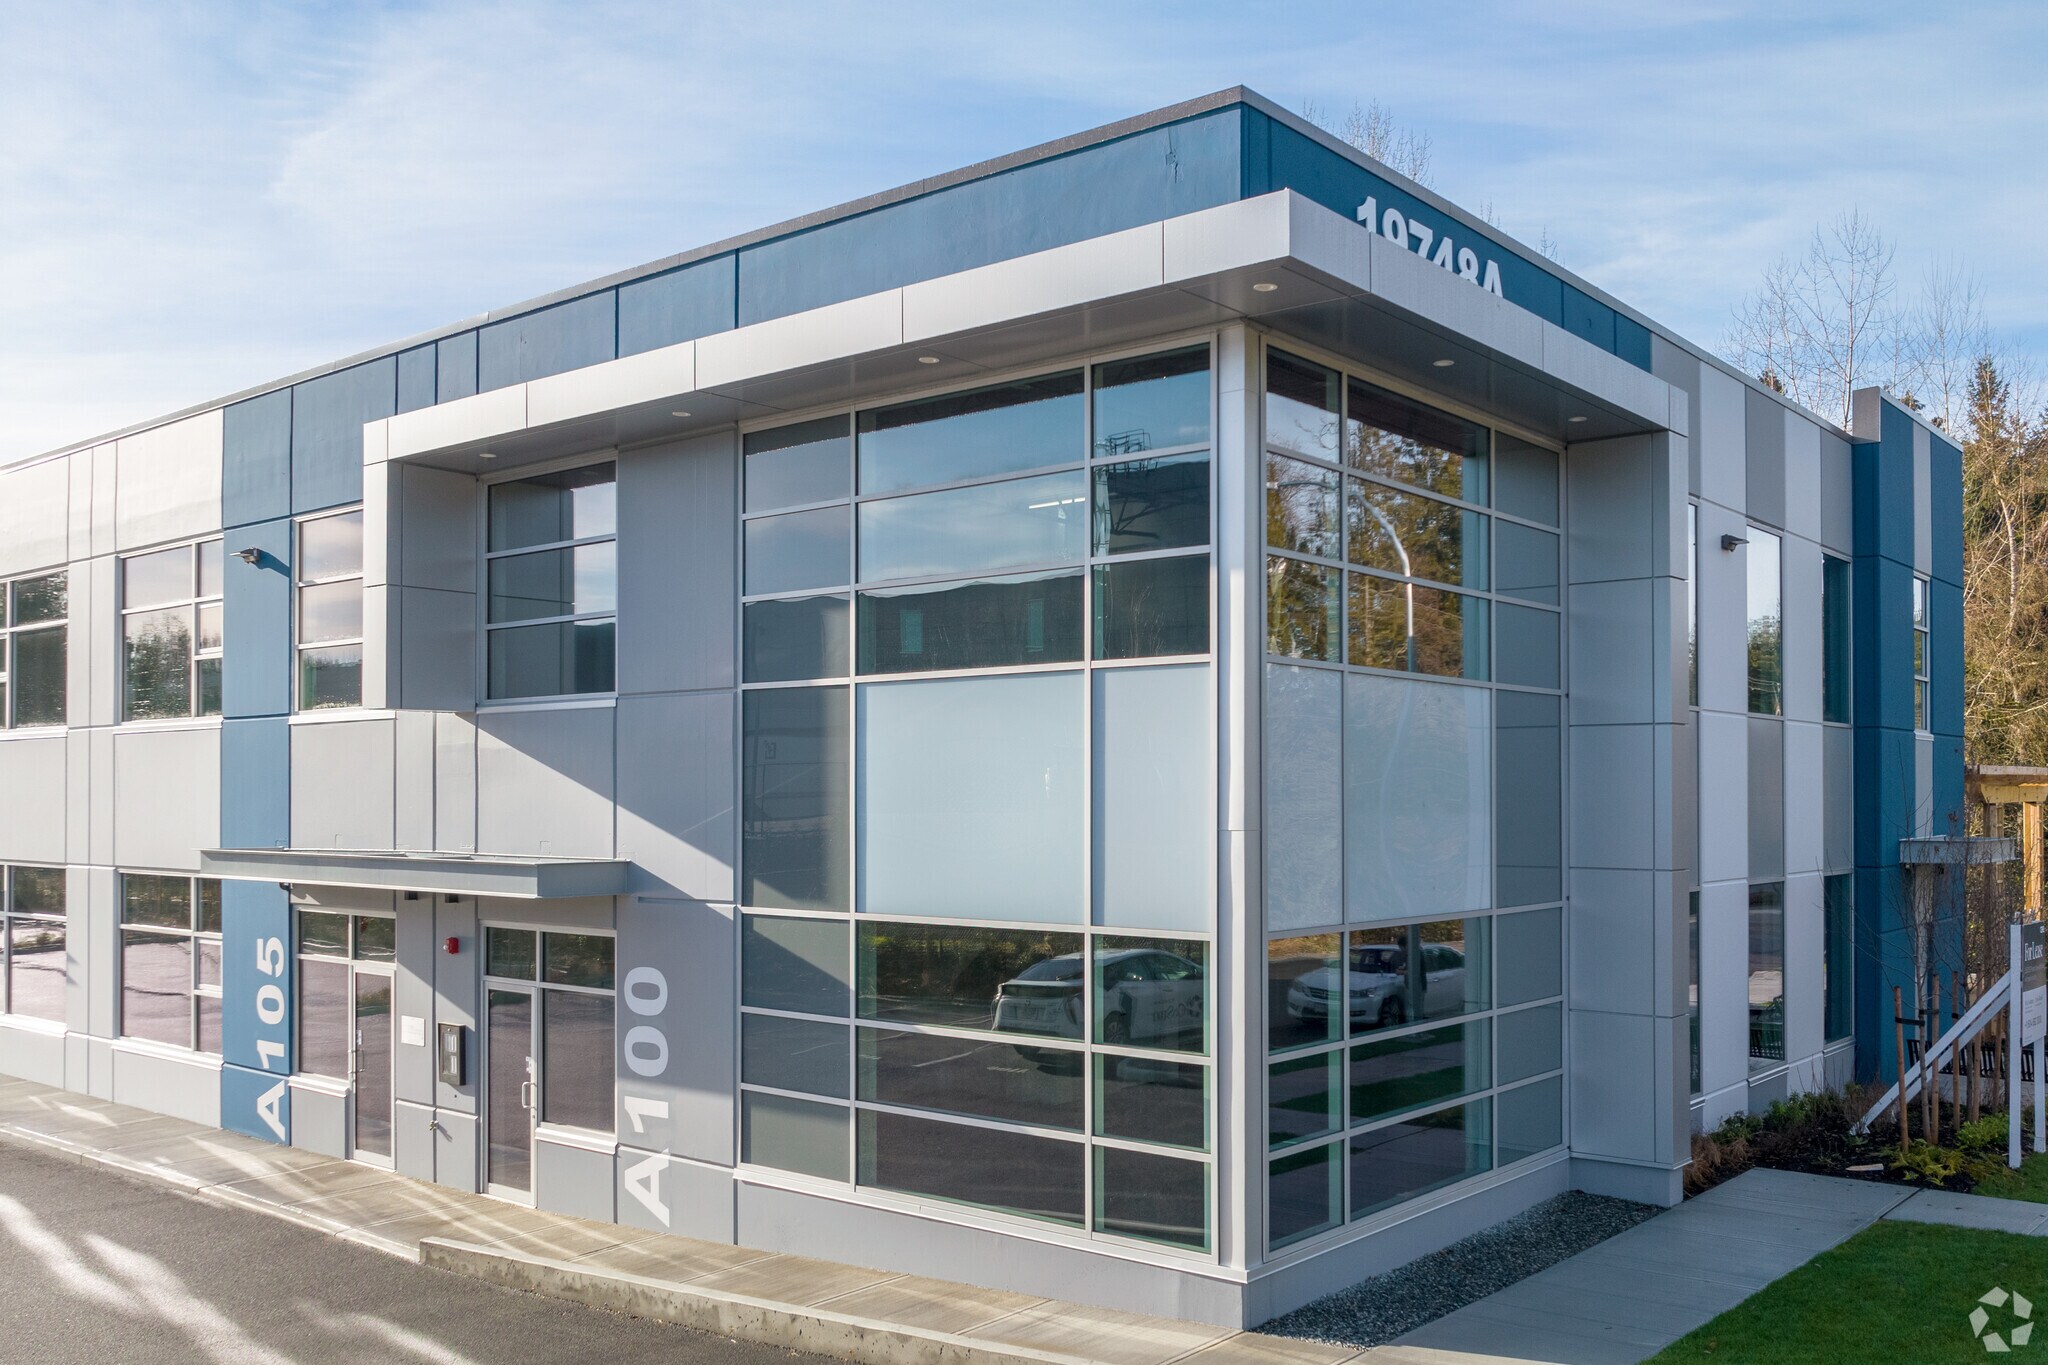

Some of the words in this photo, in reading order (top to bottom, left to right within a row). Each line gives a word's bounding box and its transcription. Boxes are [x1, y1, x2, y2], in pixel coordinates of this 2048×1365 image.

[256, 936, 286, 1142] A105
[2024, 942, 2032, 962] For
[2032, 941, 2044, 960] Lease
[623, 966, 670, 1228] A100
